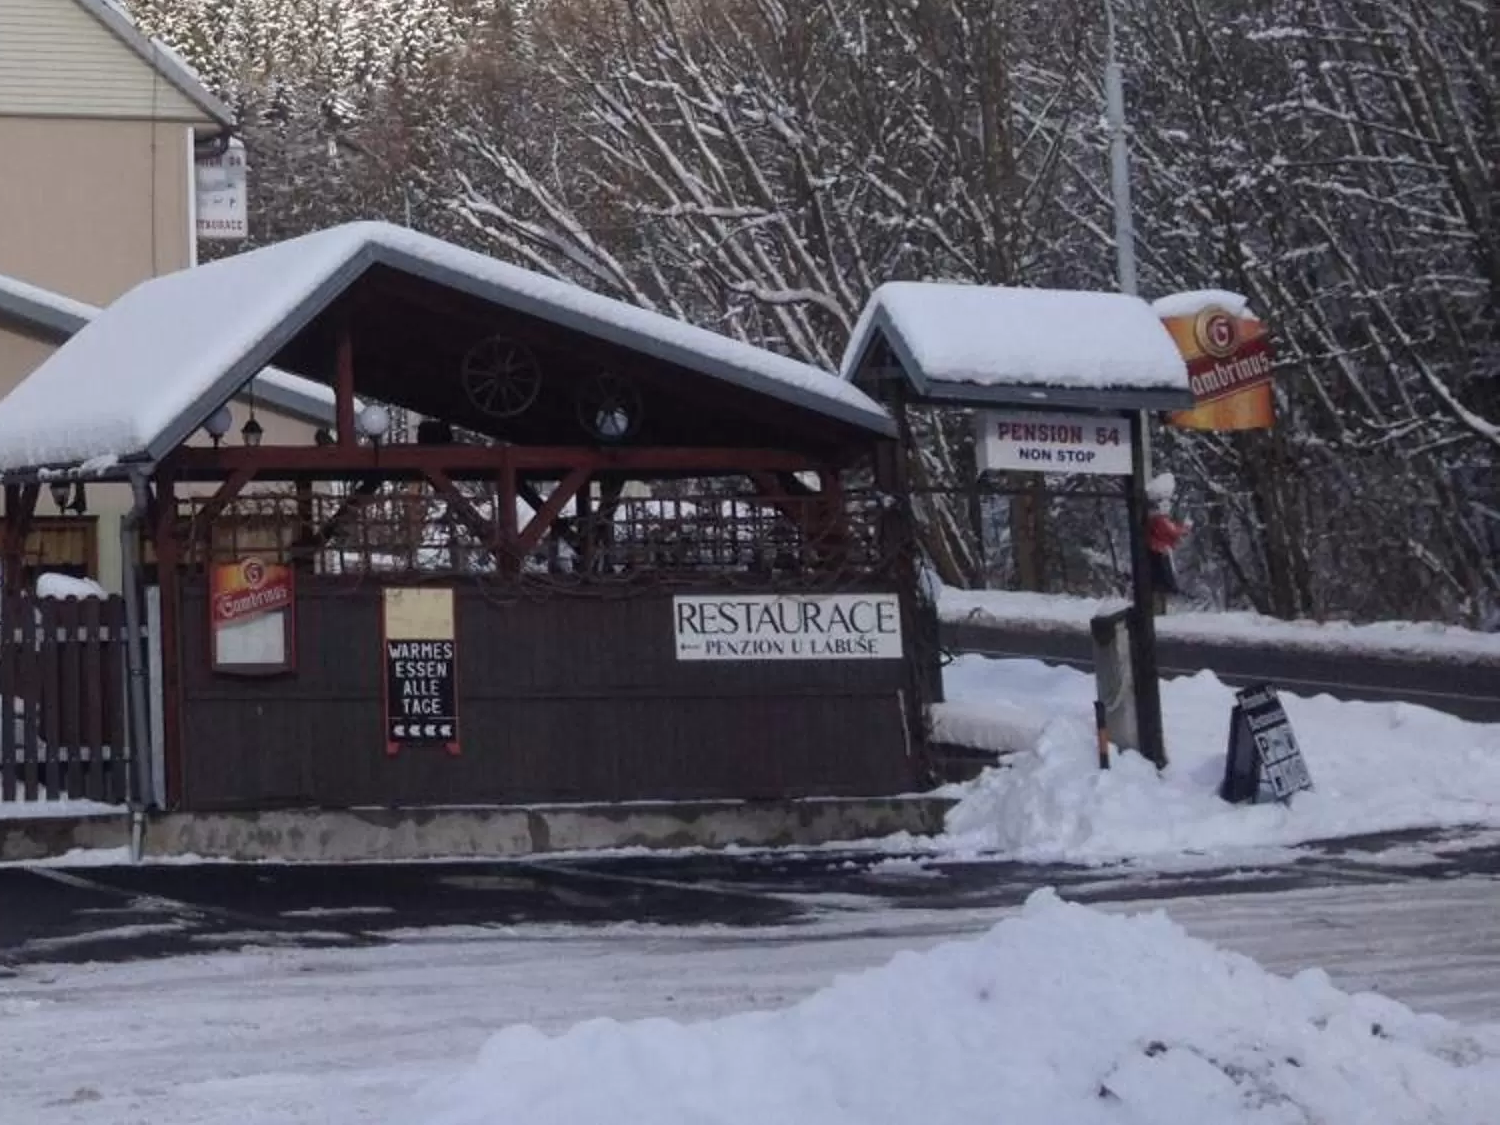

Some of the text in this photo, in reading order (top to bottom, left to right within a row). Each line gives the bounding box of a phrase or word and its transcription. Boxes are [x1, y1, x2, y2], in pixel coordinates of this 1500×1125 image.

[1191, 351, 1269, 396] ambrinus
[997, 422, 1120, 446] PENSION 54
[1018, 448, 1096, 463] NON STOP
[677, 601, 898, 635] RESTAURACE
[387, 642, 453, 659] WARMES
[705, 638, 784, 655] PENZION
[791, 639, 803, 654] U
[395, 661, 448, 677] ESSEN
[403, 679, 440, 695] ALLE
